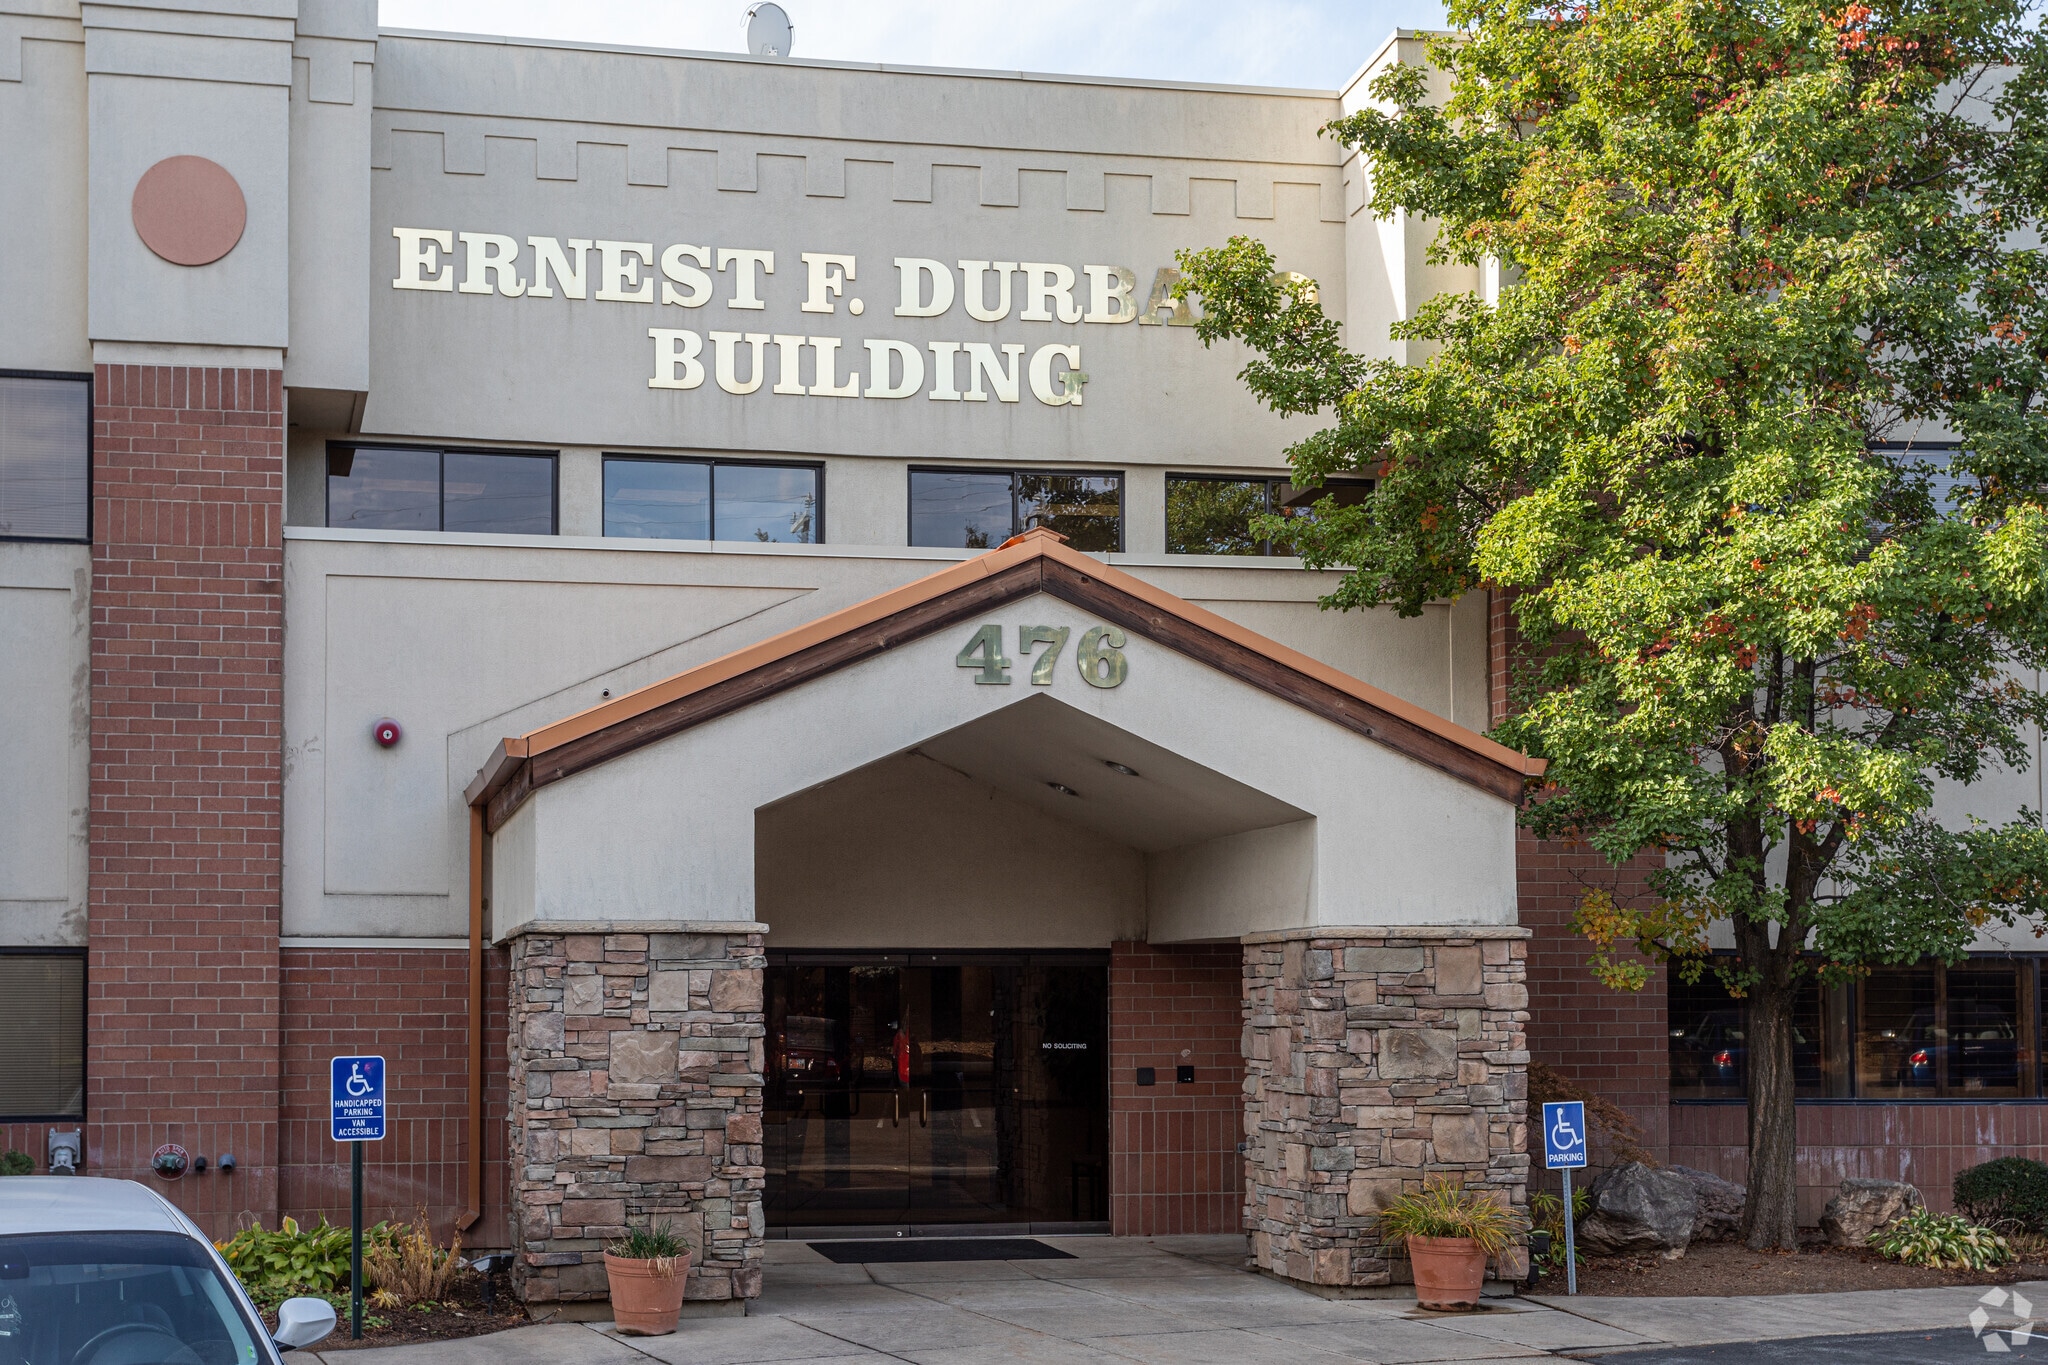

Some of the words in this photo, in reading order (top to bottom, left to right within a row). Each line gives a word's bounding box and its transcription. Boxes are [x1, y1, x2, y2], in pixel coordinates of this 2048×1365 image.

[392, 227, 774, 310] ERNEST
[801, 252, 864, 316] F.
[648, 327, 1089, 407] BUILDING
[956, 624, 1128, 689] 476
[335, 1099, 382, 1108] HANDICAPPED
[344, 1108, 373, 1116] PARKING
[352, 1119, 366, 1127] VAN
[338, 1127, 379, 1136] ACCESSIBLE
[1549, 1152, 1583, 1162] PARKING
